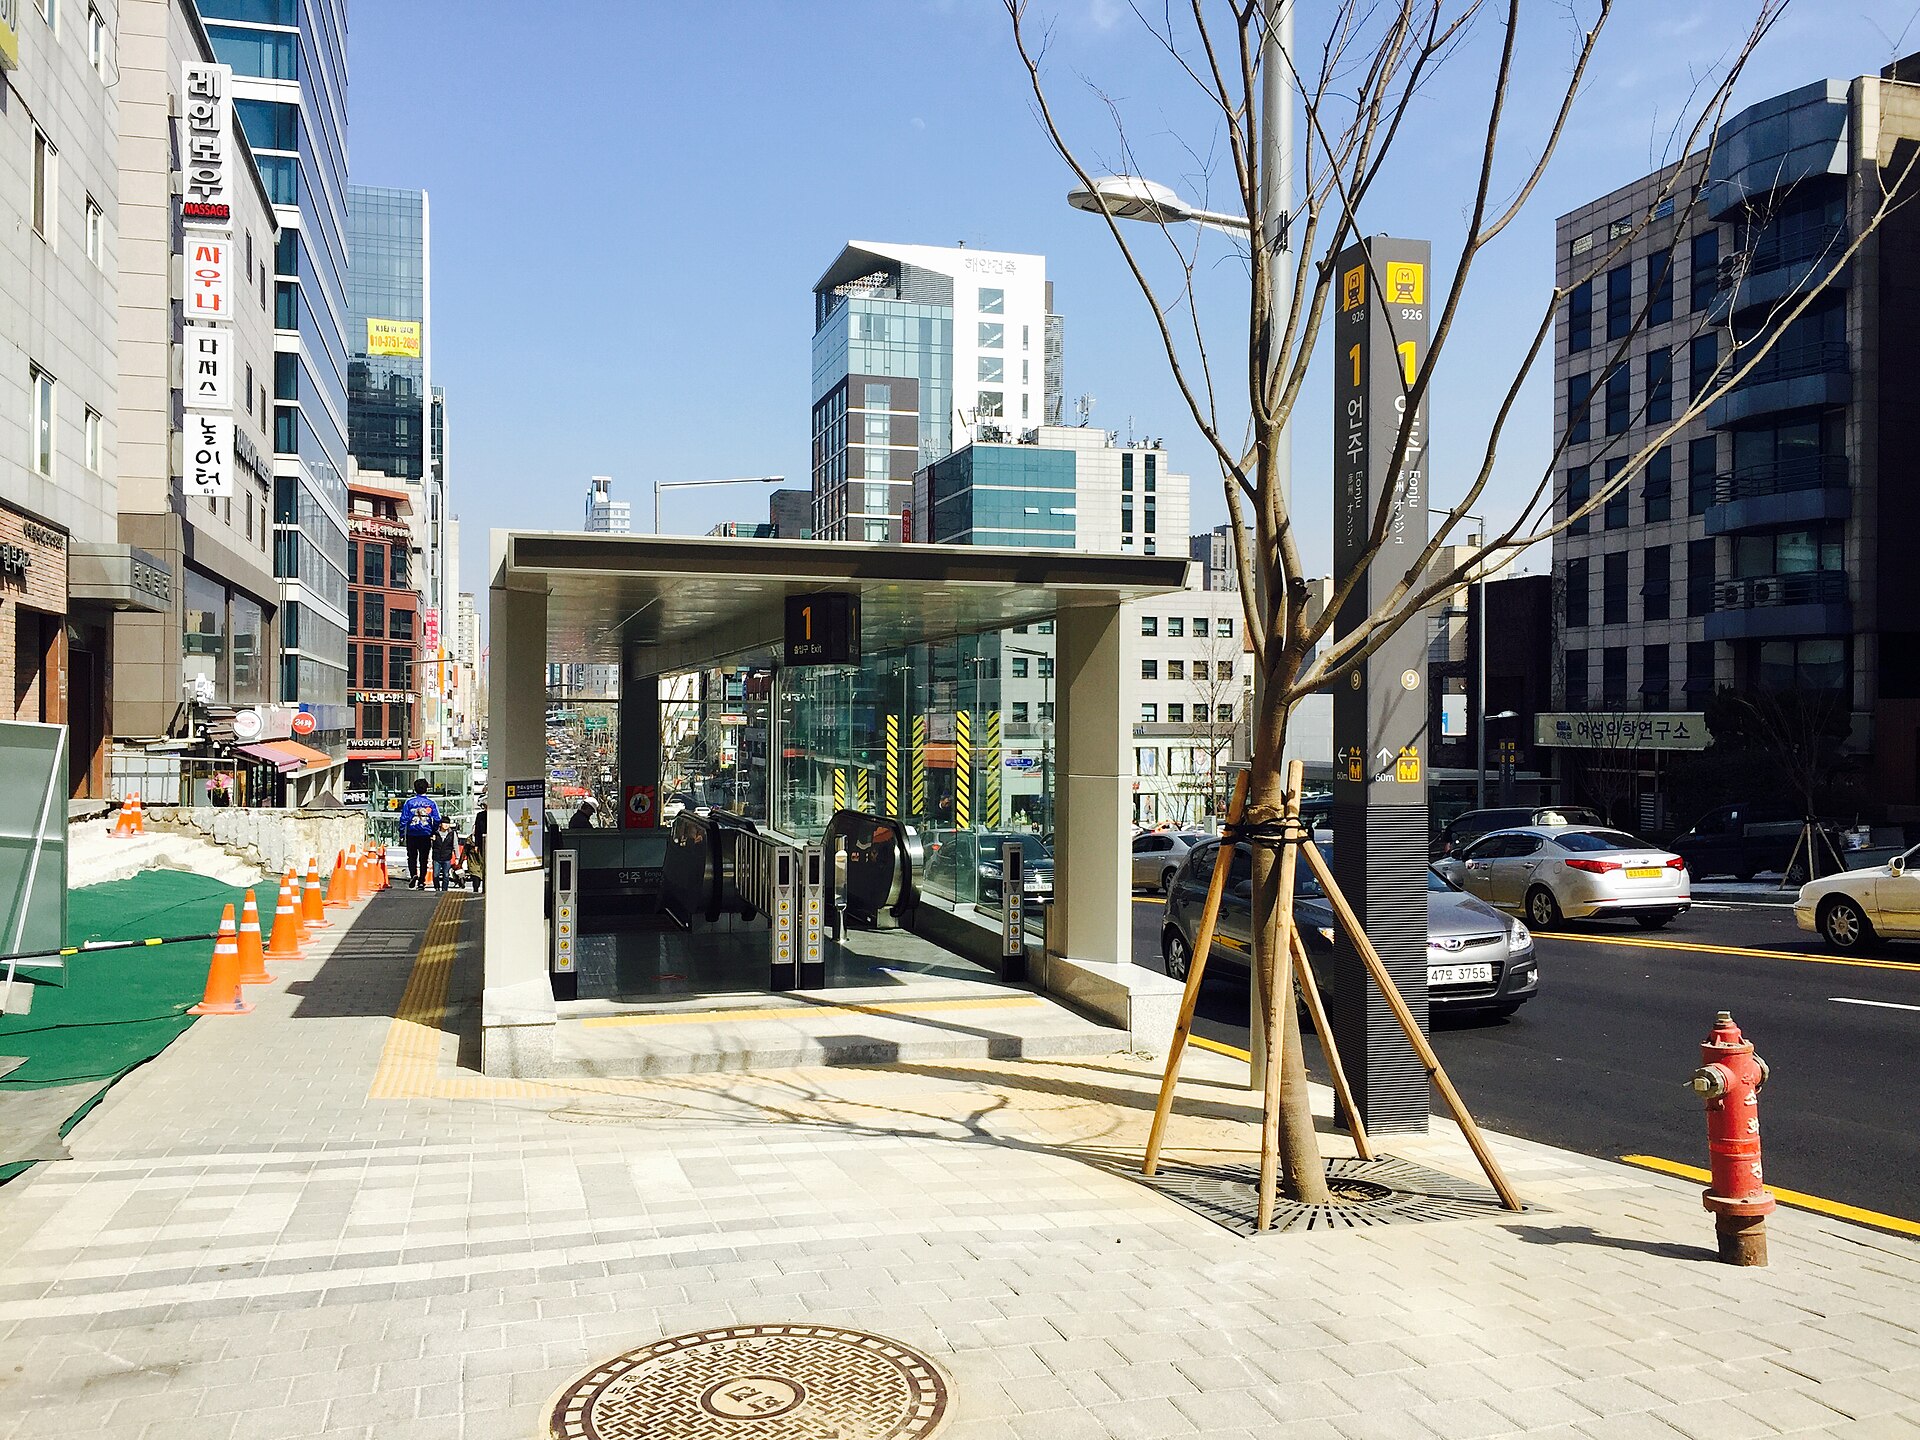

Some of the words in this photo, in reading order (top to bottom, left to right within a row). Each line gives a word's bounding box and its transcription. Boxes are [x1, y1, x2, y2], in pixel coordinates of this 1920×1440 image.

[188, 69, 223, 199] 레인보우
[184, 202, 230, 219] MASSAGE
[965, 258, 1016, 276] 해안건축
[194, 246, 222, 311] 사우나
[1352, 310, 1365, 324] 926
[1401, 309, 1423, 321] 926
[1349, 343, 1361, 387] 1
[1397, 341, 1416, 385] 1
[1347, 395, 1364, 464] 언주
[195, 417, 221, 486] 놀이터
[1355, 470, 1363, 509] Eonju
[1406, 470, 1421, 508] Eonju
[802, 606, 811, 640] 1
[810, 643, 822, 654] Exit
[1577, 720, 1691, 741] 여성의학연구소
[1336, 771, 1348, 781] 60m
[1375, 773, 1395, 782] 60m
[619, 871, 641, 884] 언주
[1458, 967, 1486, 980] 3755
